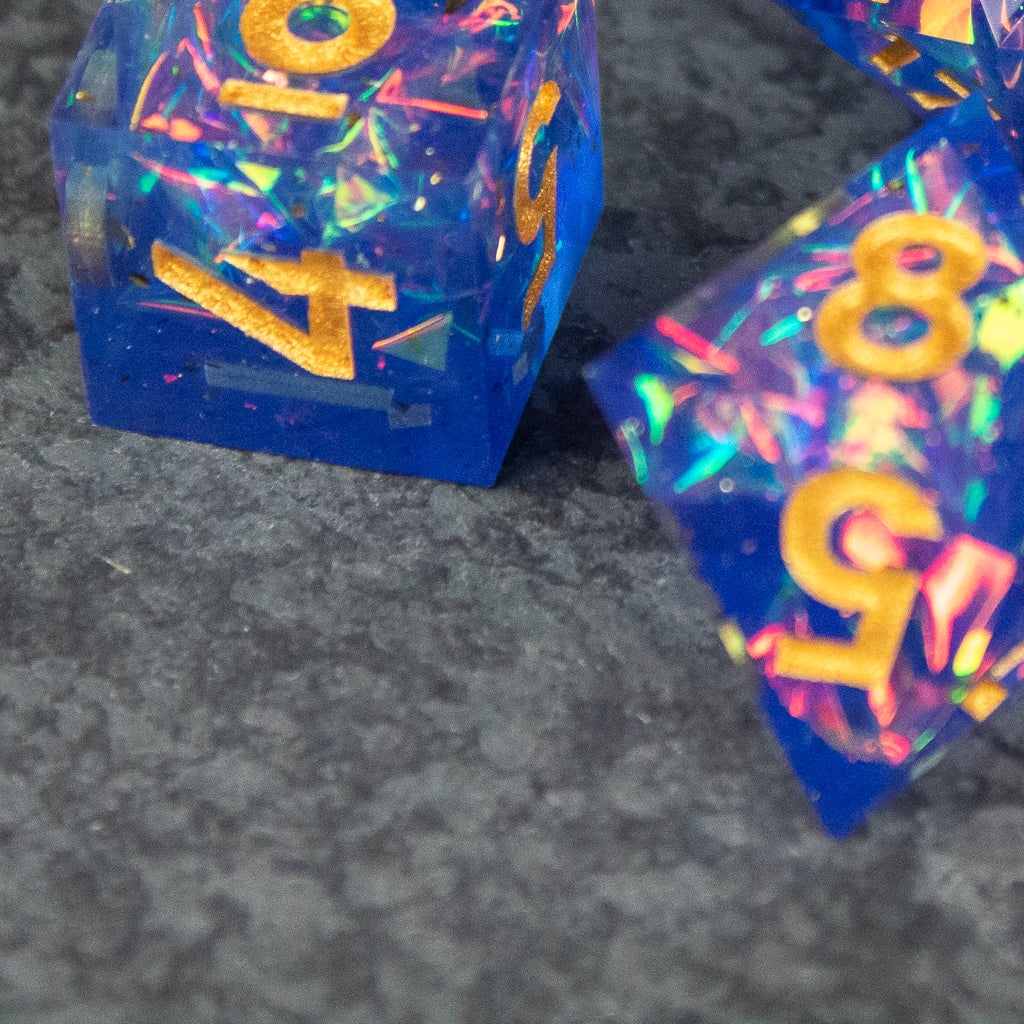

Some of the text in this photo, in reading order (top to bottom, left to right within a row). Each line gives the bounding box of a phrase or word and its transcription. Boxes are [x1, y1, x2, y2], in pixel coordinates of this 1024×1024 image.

[151, 240, 397, 381] 4
[815, 212, 989, 382] 8
[775, 470, 945, 689] 5
